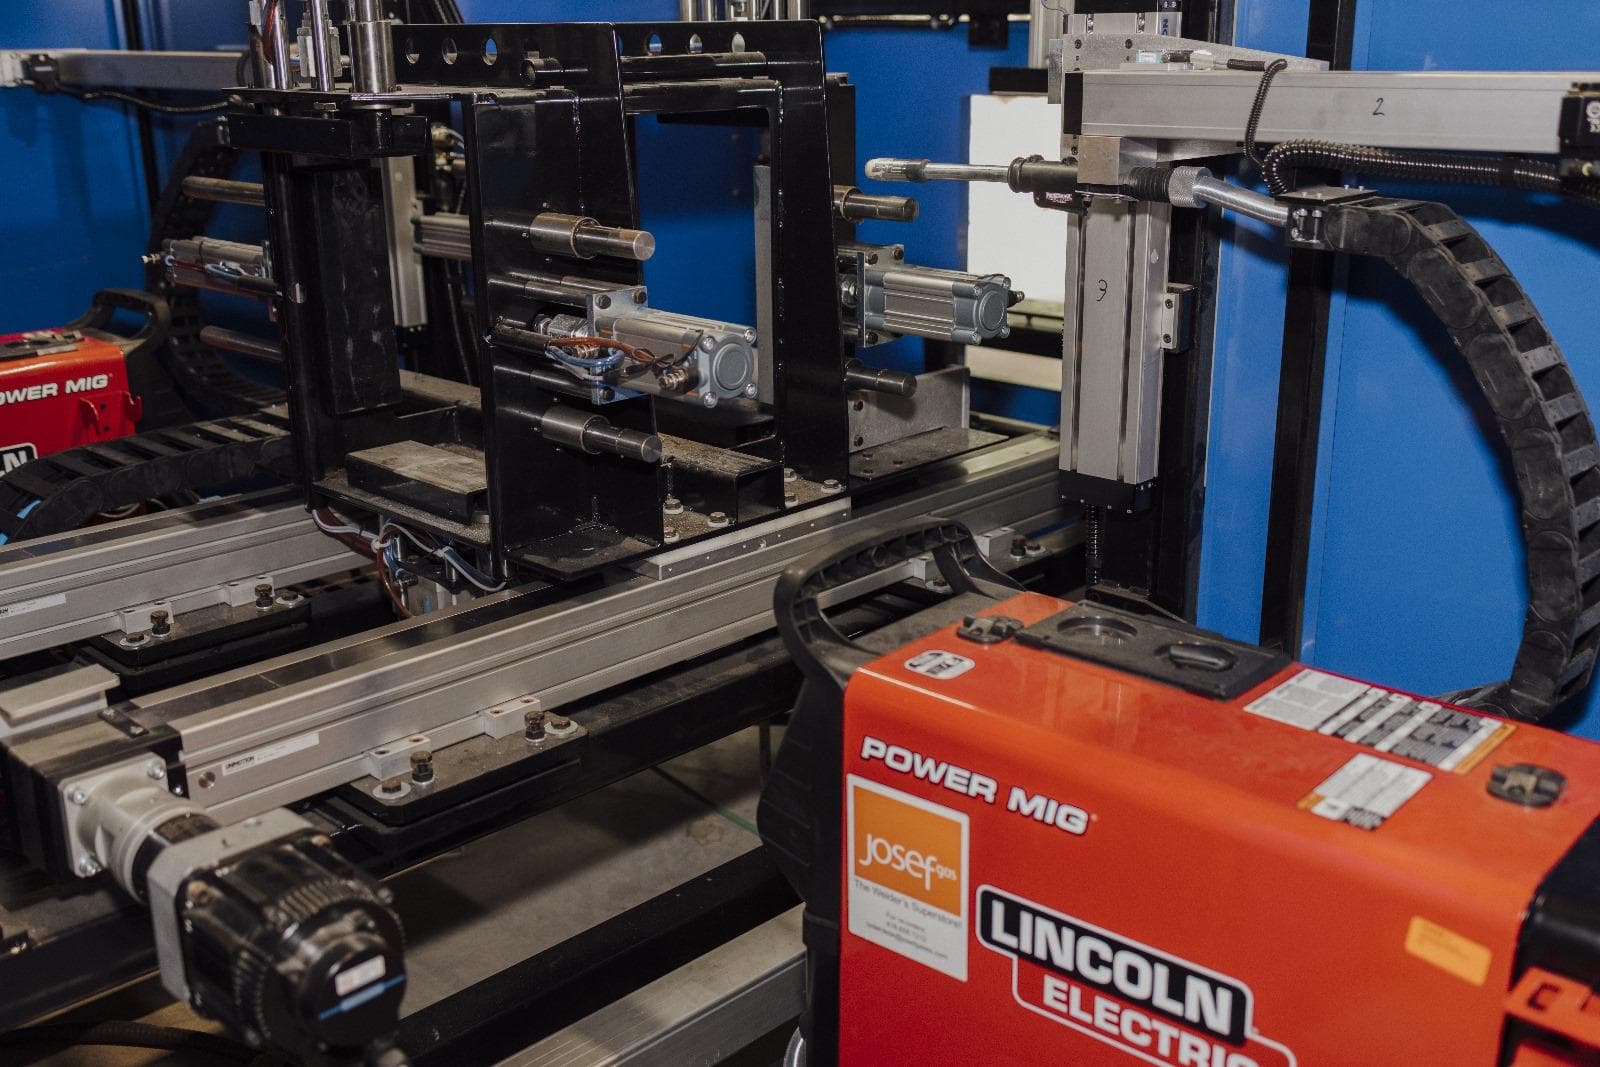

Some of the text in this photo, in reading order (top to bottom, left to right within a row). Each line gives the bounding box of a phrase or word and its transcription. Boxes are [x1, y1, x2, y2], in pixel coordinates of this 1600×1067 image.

[1372, 97, 1385, 116] 2
[65, 374, 109, 394] MIG
[860, 735, 1089, 835] POWER MIG
[991, 899, 1233, 1036] LINCOLN
